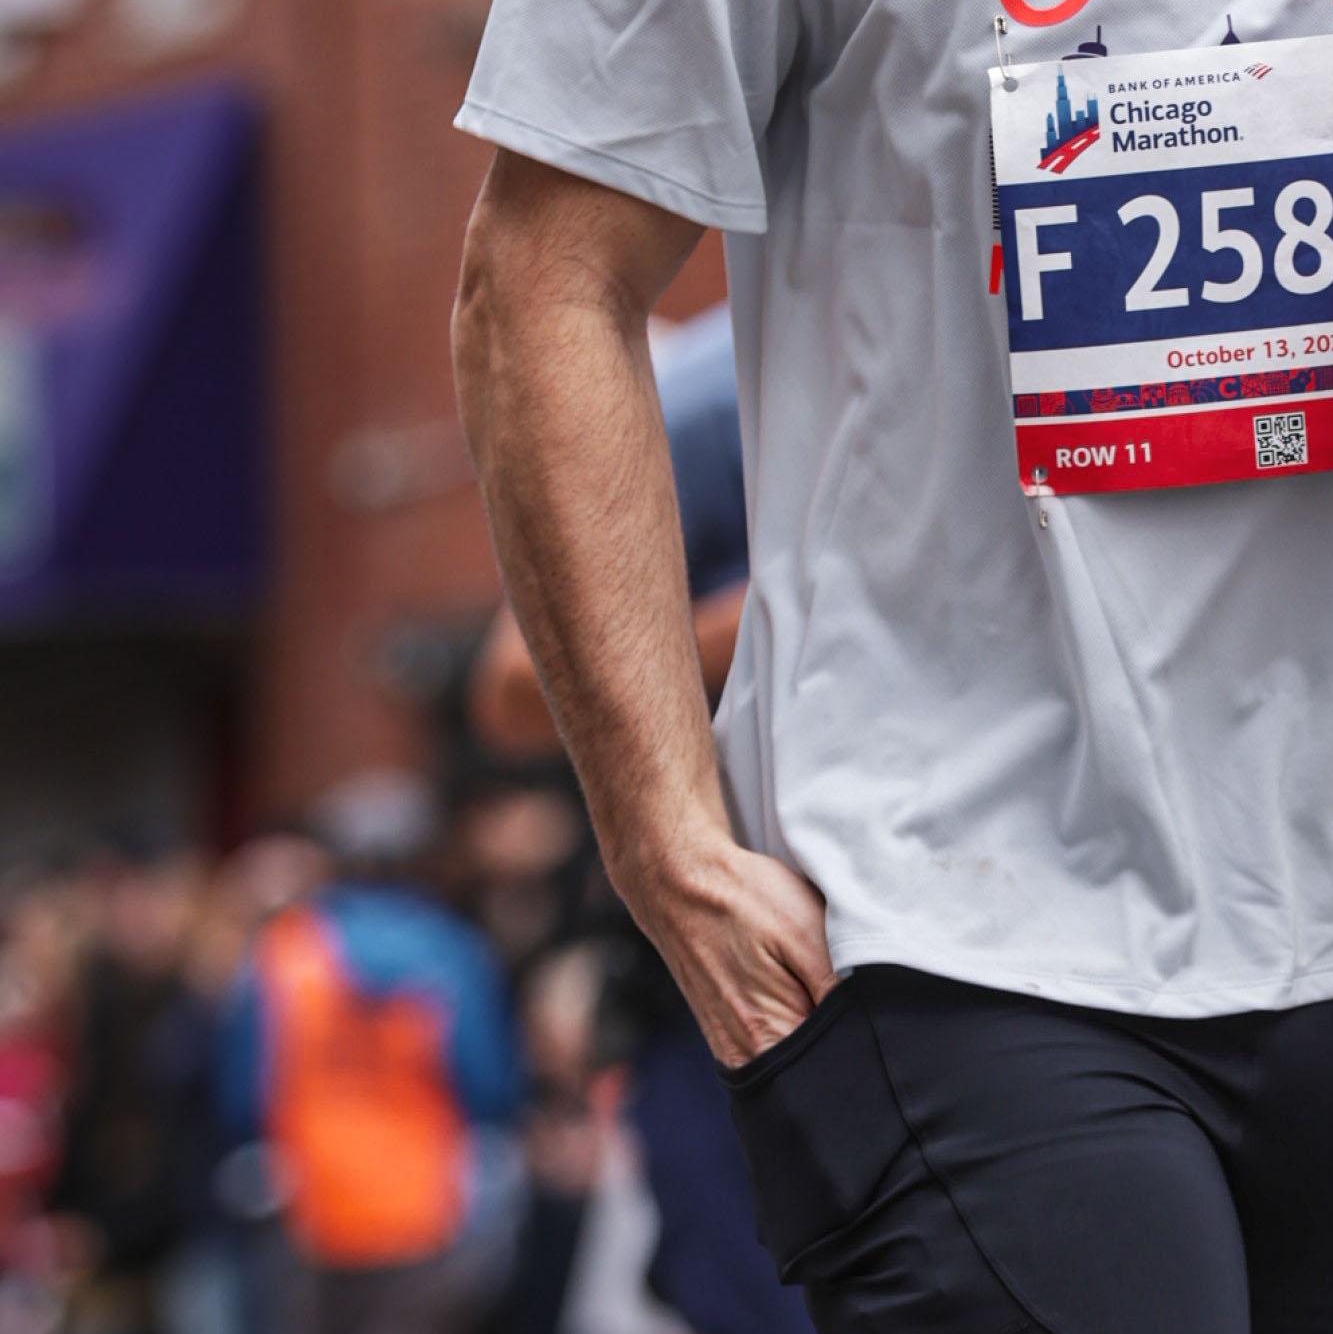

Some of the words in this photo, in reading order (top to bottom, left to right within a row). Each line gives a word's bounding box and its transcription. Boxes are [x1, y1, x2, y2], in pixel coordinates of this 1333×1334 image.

[1108, 79, 1148, 94] BANK
[1152, 77, 1170, 90] OF
[1175, 72, 1241, 87] AMERICA
[1110, 100, 1212, 124] Chicago
[1112, 124, 1239, 153] Marathon
[1013, 203, 1078, 321] F
[1167, 344, 1256, 369] October
[1264, 339, 1297, 362] 13,
[1055, 446, 1117, 469] ROW
[1124, 443, 1153, 464] 11
